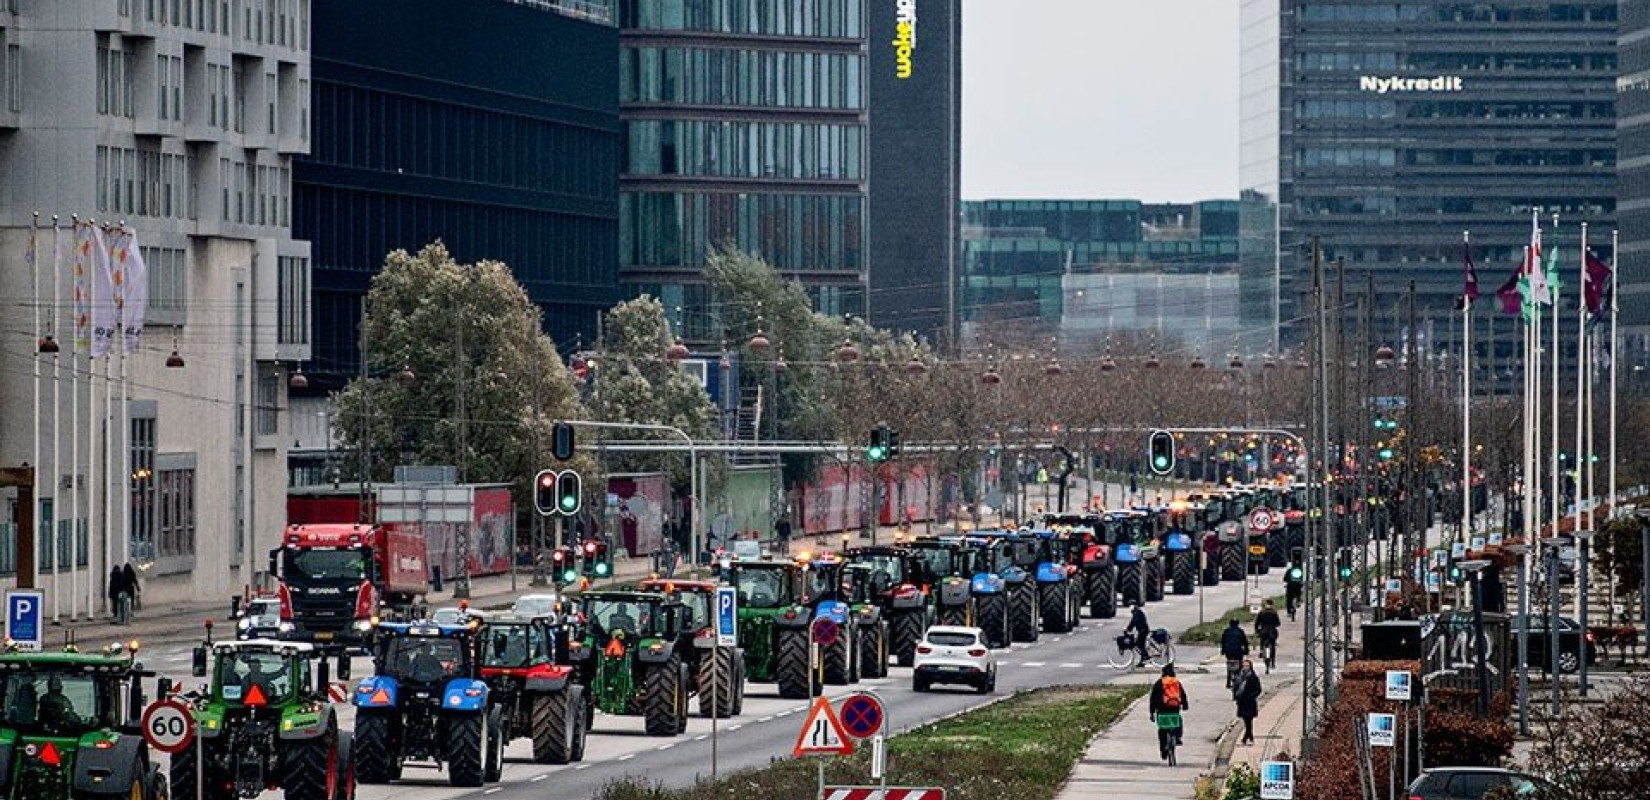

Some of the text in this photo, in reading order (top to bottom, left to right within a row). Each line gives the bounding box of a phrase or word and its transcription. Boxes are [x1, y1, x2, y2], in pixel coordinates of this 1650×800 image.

[1360, 75, 1463, 93] Nykredit
[16, 599, 31, 621] P
[722, 595, 731, 616] P
[152, 716, 184, 736] 60
